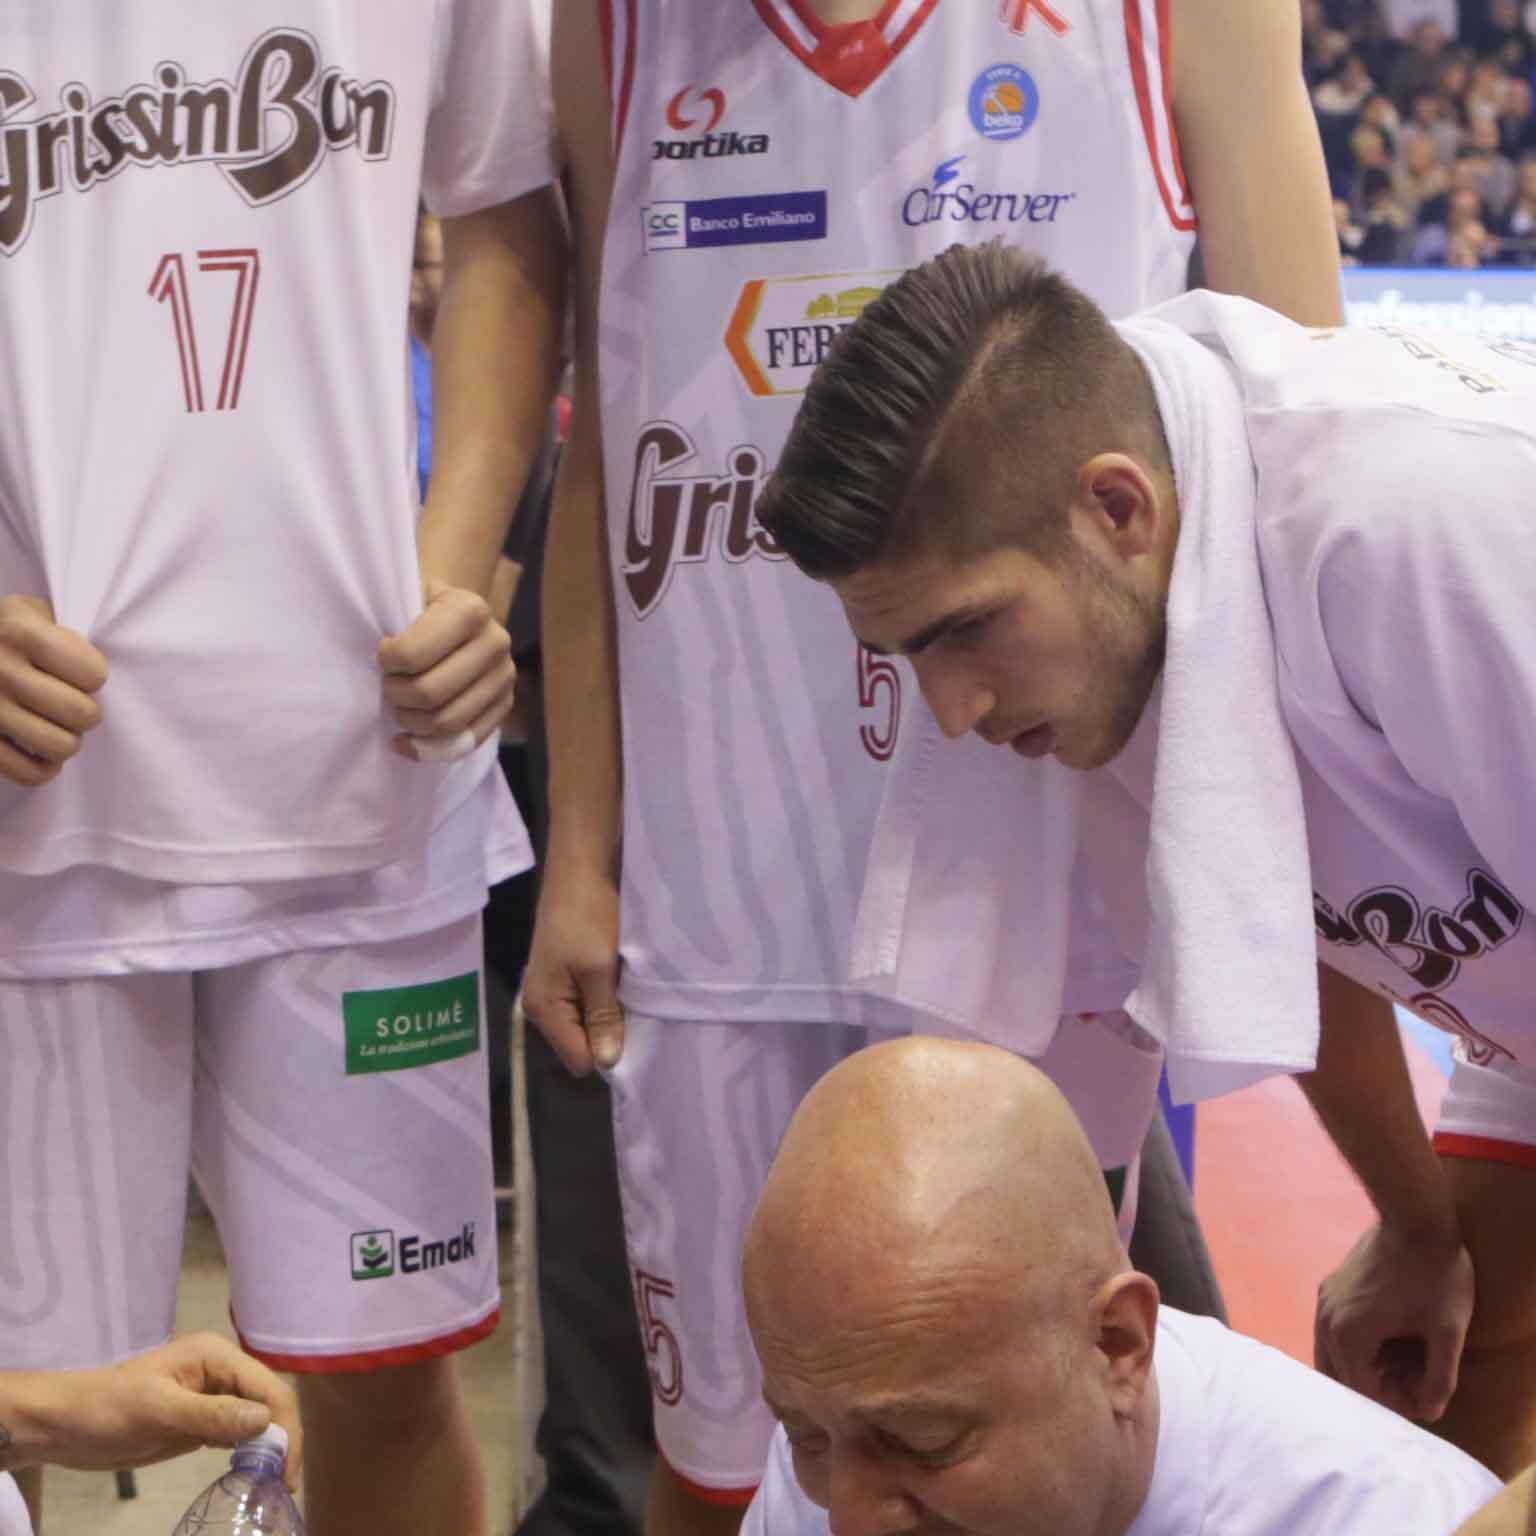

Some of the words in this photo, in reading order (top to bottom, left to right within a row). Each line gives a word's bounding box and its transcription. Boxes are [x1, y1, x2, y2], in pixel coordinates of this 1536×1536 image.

[689, 217, 739, 232] Banco
[742, 210, 816, 228] Emiliano
[147, 249, 258, 413] 17
[398, 1223, 476, 1274] Emak
[636, 1268, 683, 1406] 5
